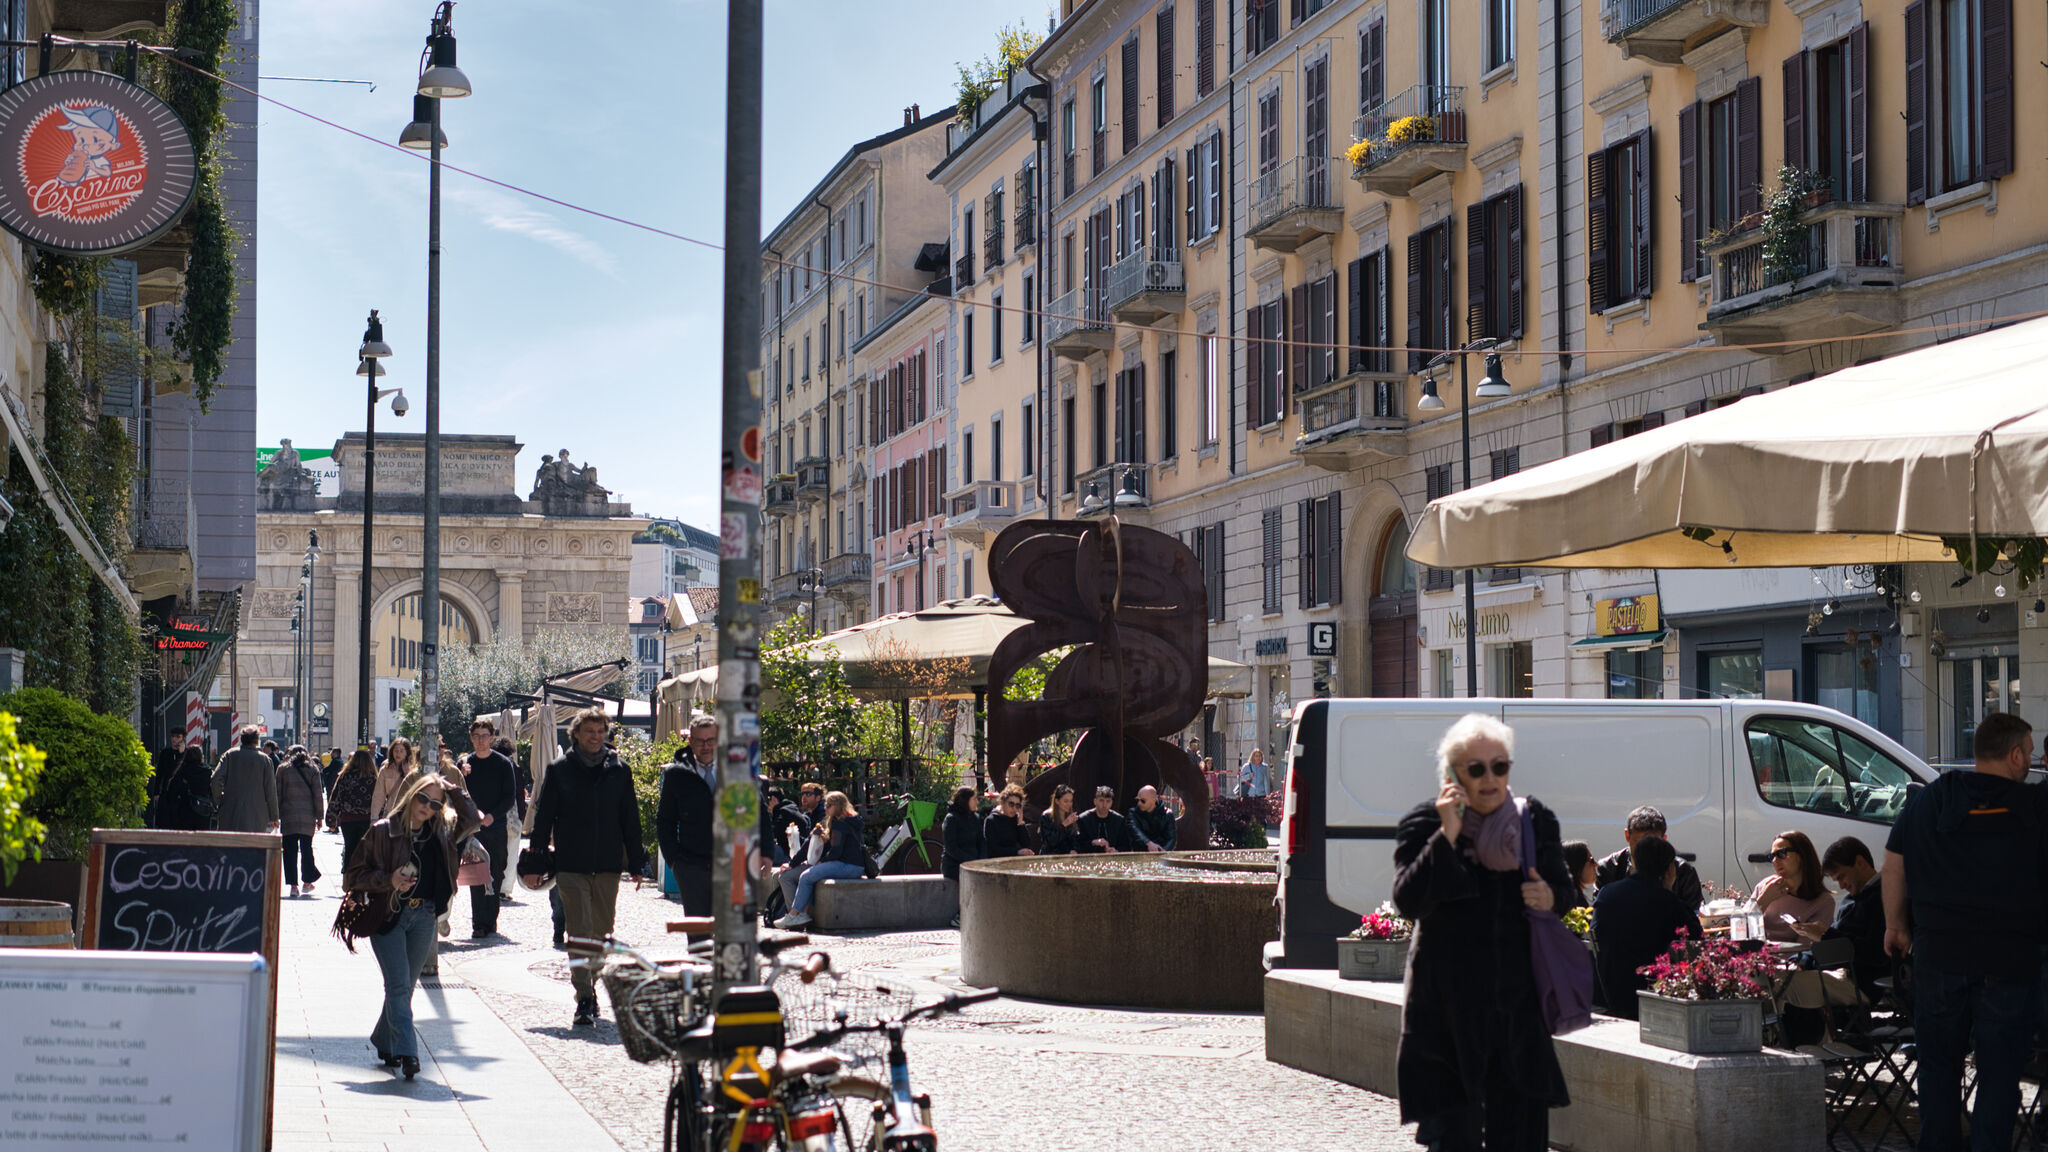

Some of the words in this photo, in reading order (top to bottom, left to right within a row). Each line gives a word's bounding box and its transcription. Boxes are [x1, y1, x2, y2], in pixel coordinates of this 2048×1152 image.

[27, 172, 142, 214] Cesarino
[1313, 624, 1333, 649] G
[110, 848, 264, 894] Cesarino
